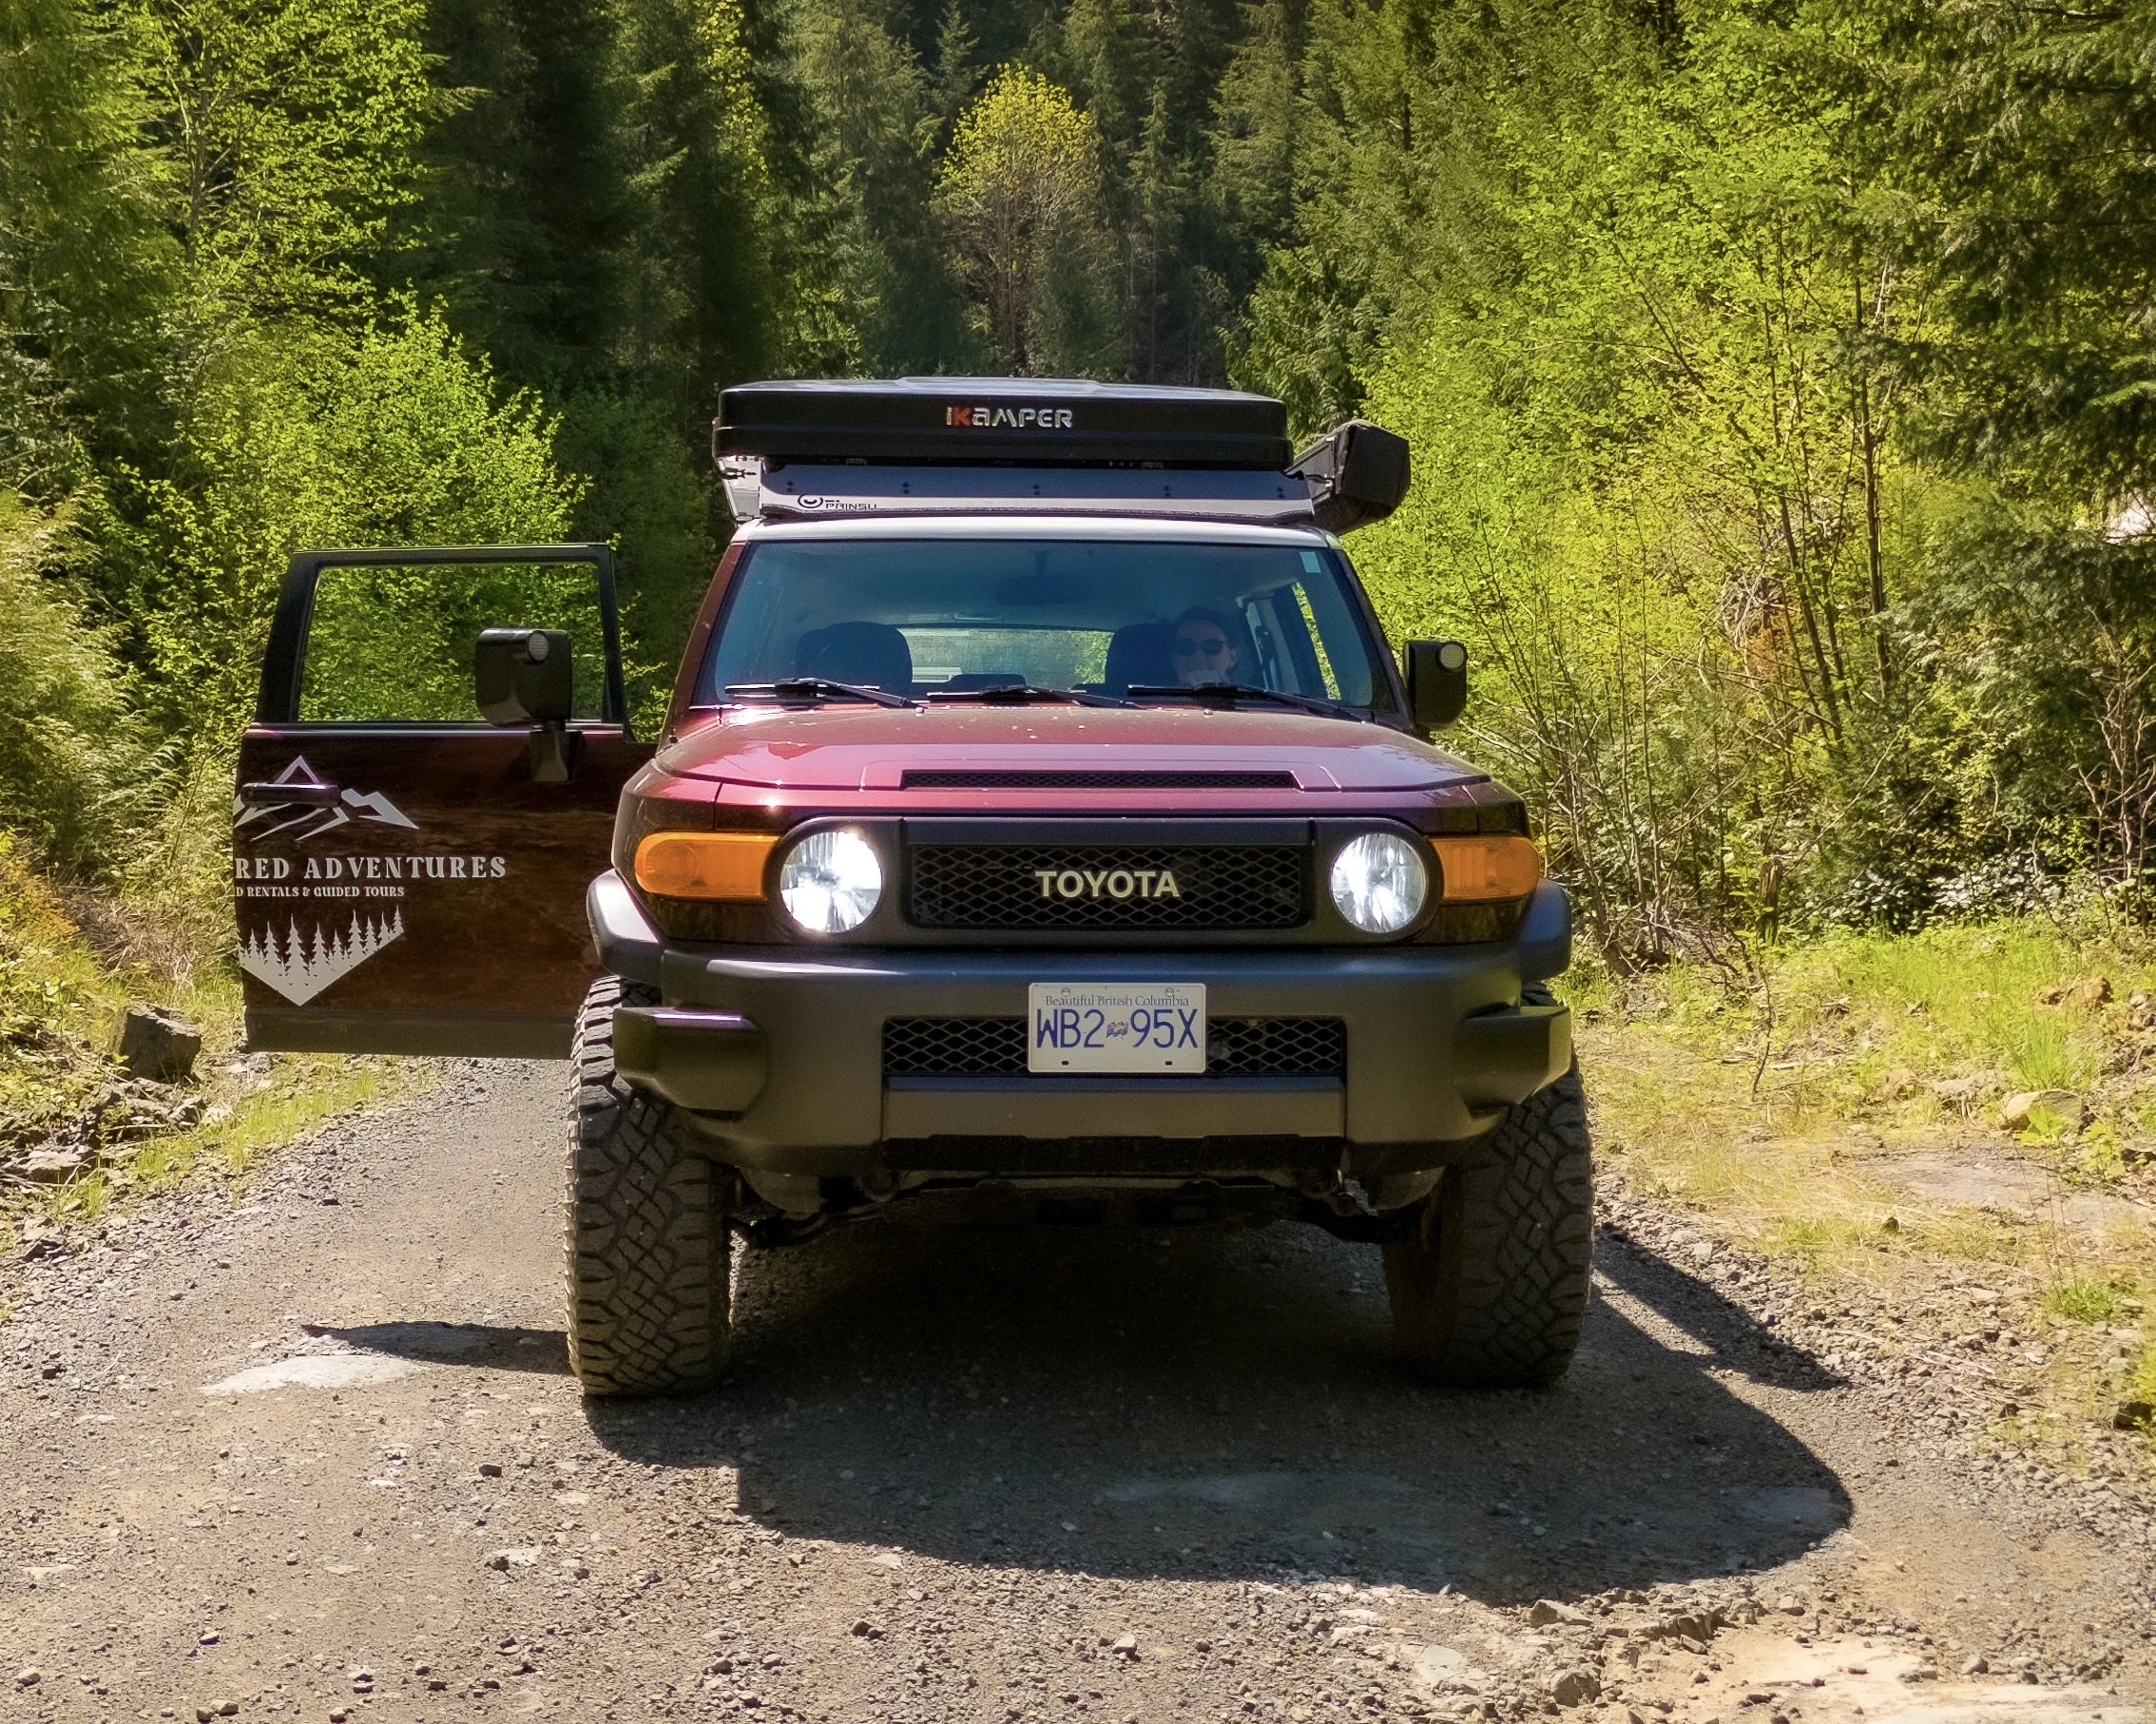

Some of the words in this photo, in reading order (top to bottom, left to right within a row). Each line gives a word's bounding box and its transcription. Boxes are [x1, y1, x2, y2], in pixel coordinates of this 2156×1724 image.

[824, 499, 877, 510] PRINSU
[235, 857, 290, 879] RED
[304, 856, 506, 879] ADVENTURES
[247, 886, 299, 897] RENTALS
[302, 886, 311, 897] &
[314, 886, 360, 897] GUIDED
[364, 886, 405, 897] TOURS
[1034, 871, 1180, 898] TOYOTA
[1046, 994, 1094, 1007] Beautiful
[1096, 994, 1132, 1007] British
[1135, 994, 1189, 1007] Columbia
[1036, 1008, 1105, 1048] WB2
[1130, 1008, 1198, 1048] 95X
